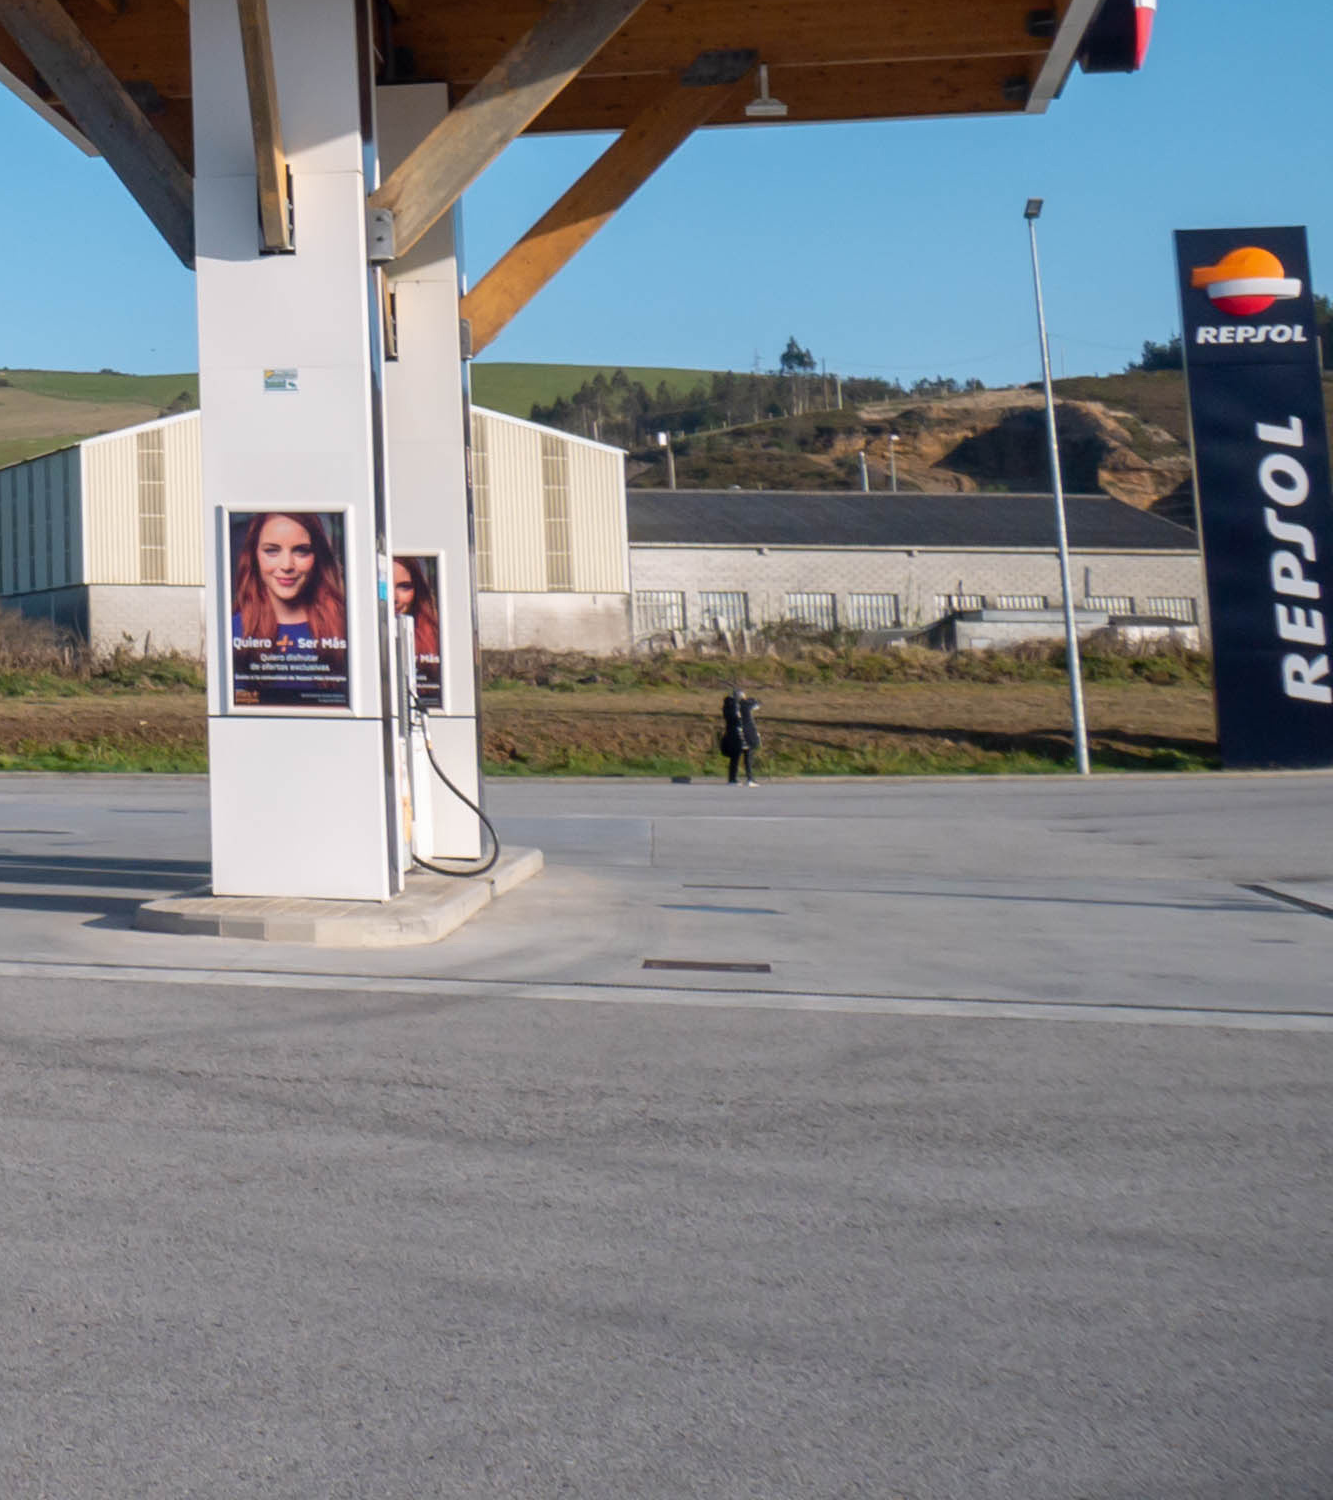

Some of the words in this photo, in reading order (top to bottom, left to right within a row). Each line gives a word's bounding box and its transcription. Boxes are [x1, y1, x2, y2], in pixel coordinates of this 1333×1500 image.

[1196, 324, 1307, 344] REPSOL
[1256, 415, 1332, 704] REPSOL
[233, 636, 272, 650] Quiero
[298, 637, 319, 649] Ser
[322, 635, 347, 649] Más
